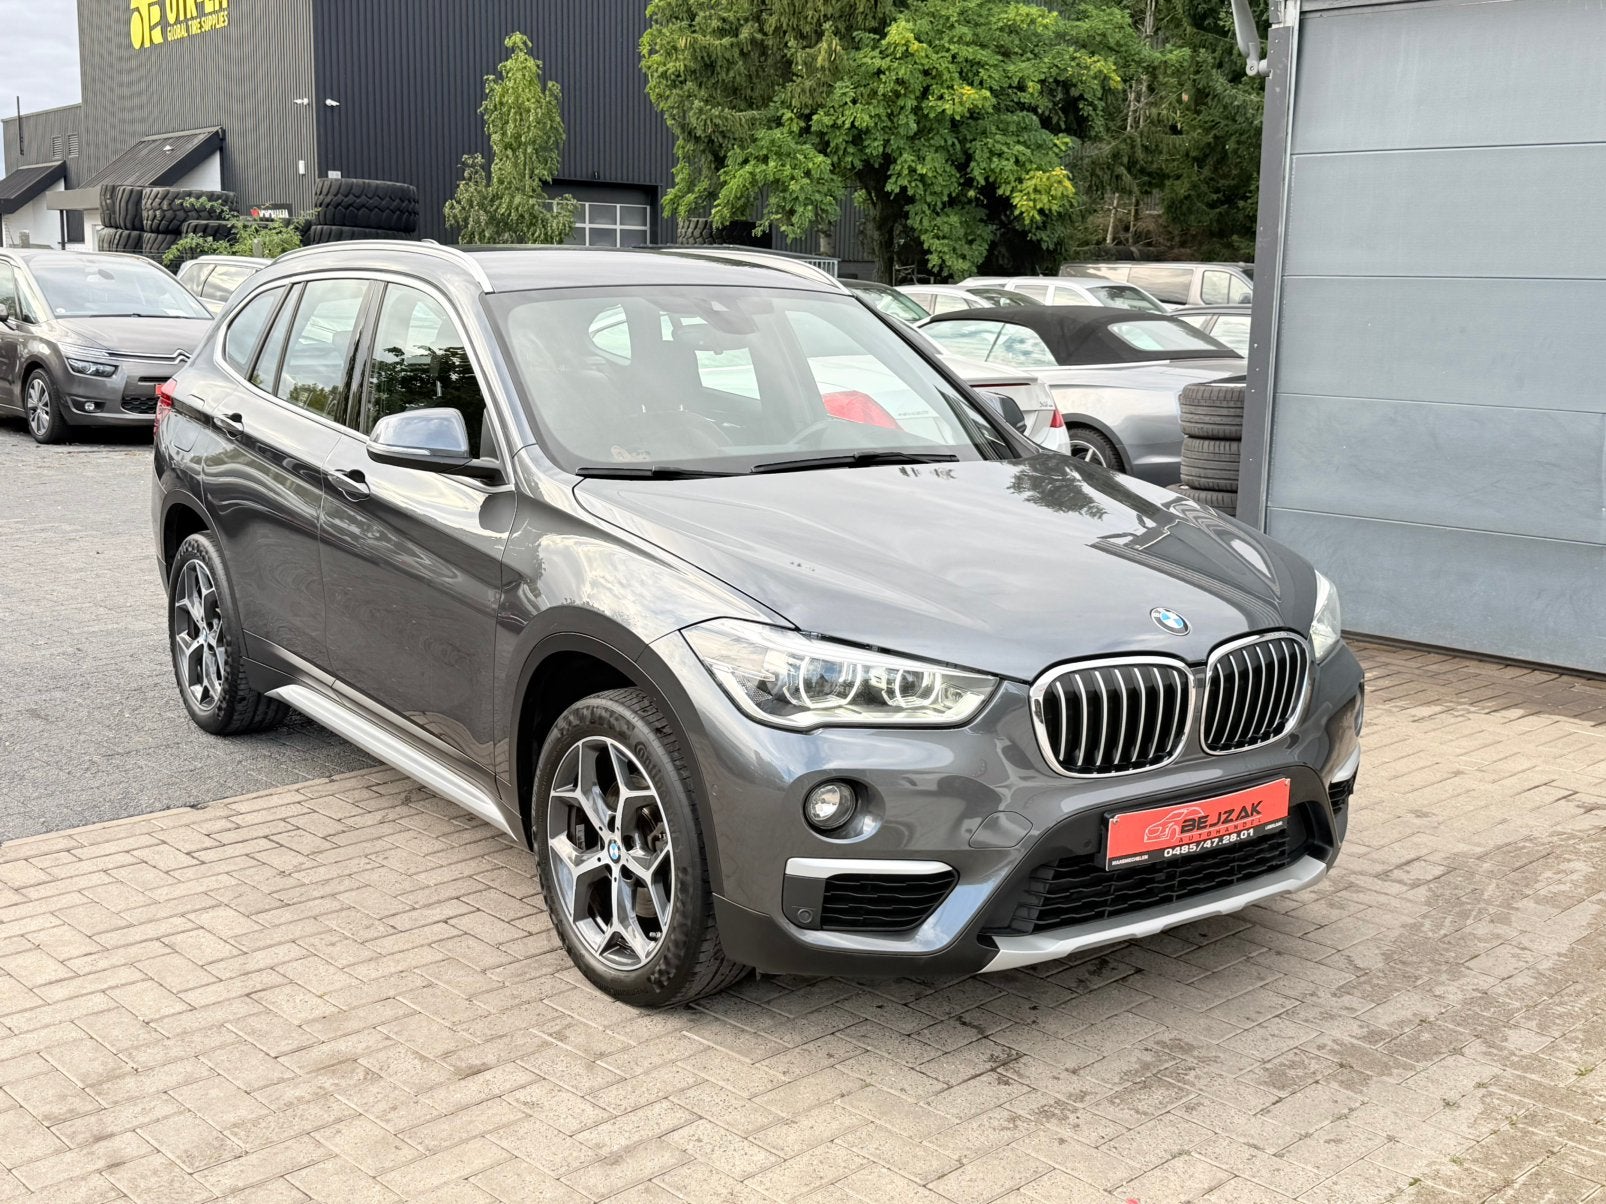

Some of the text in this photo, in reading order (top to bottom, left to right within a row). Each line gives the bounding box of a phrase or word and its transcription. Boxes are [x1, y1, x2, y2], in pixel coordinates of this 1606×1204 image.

[167, 11, 228, 41] GLOBAL TIRE SUPPLIES
[1178, 818, 1262, 843] AUTOHANDEL
[1180, 800, 1263, 834] BEJZAK
[1163, 828, 1255, 857] 0485/47.28.01
